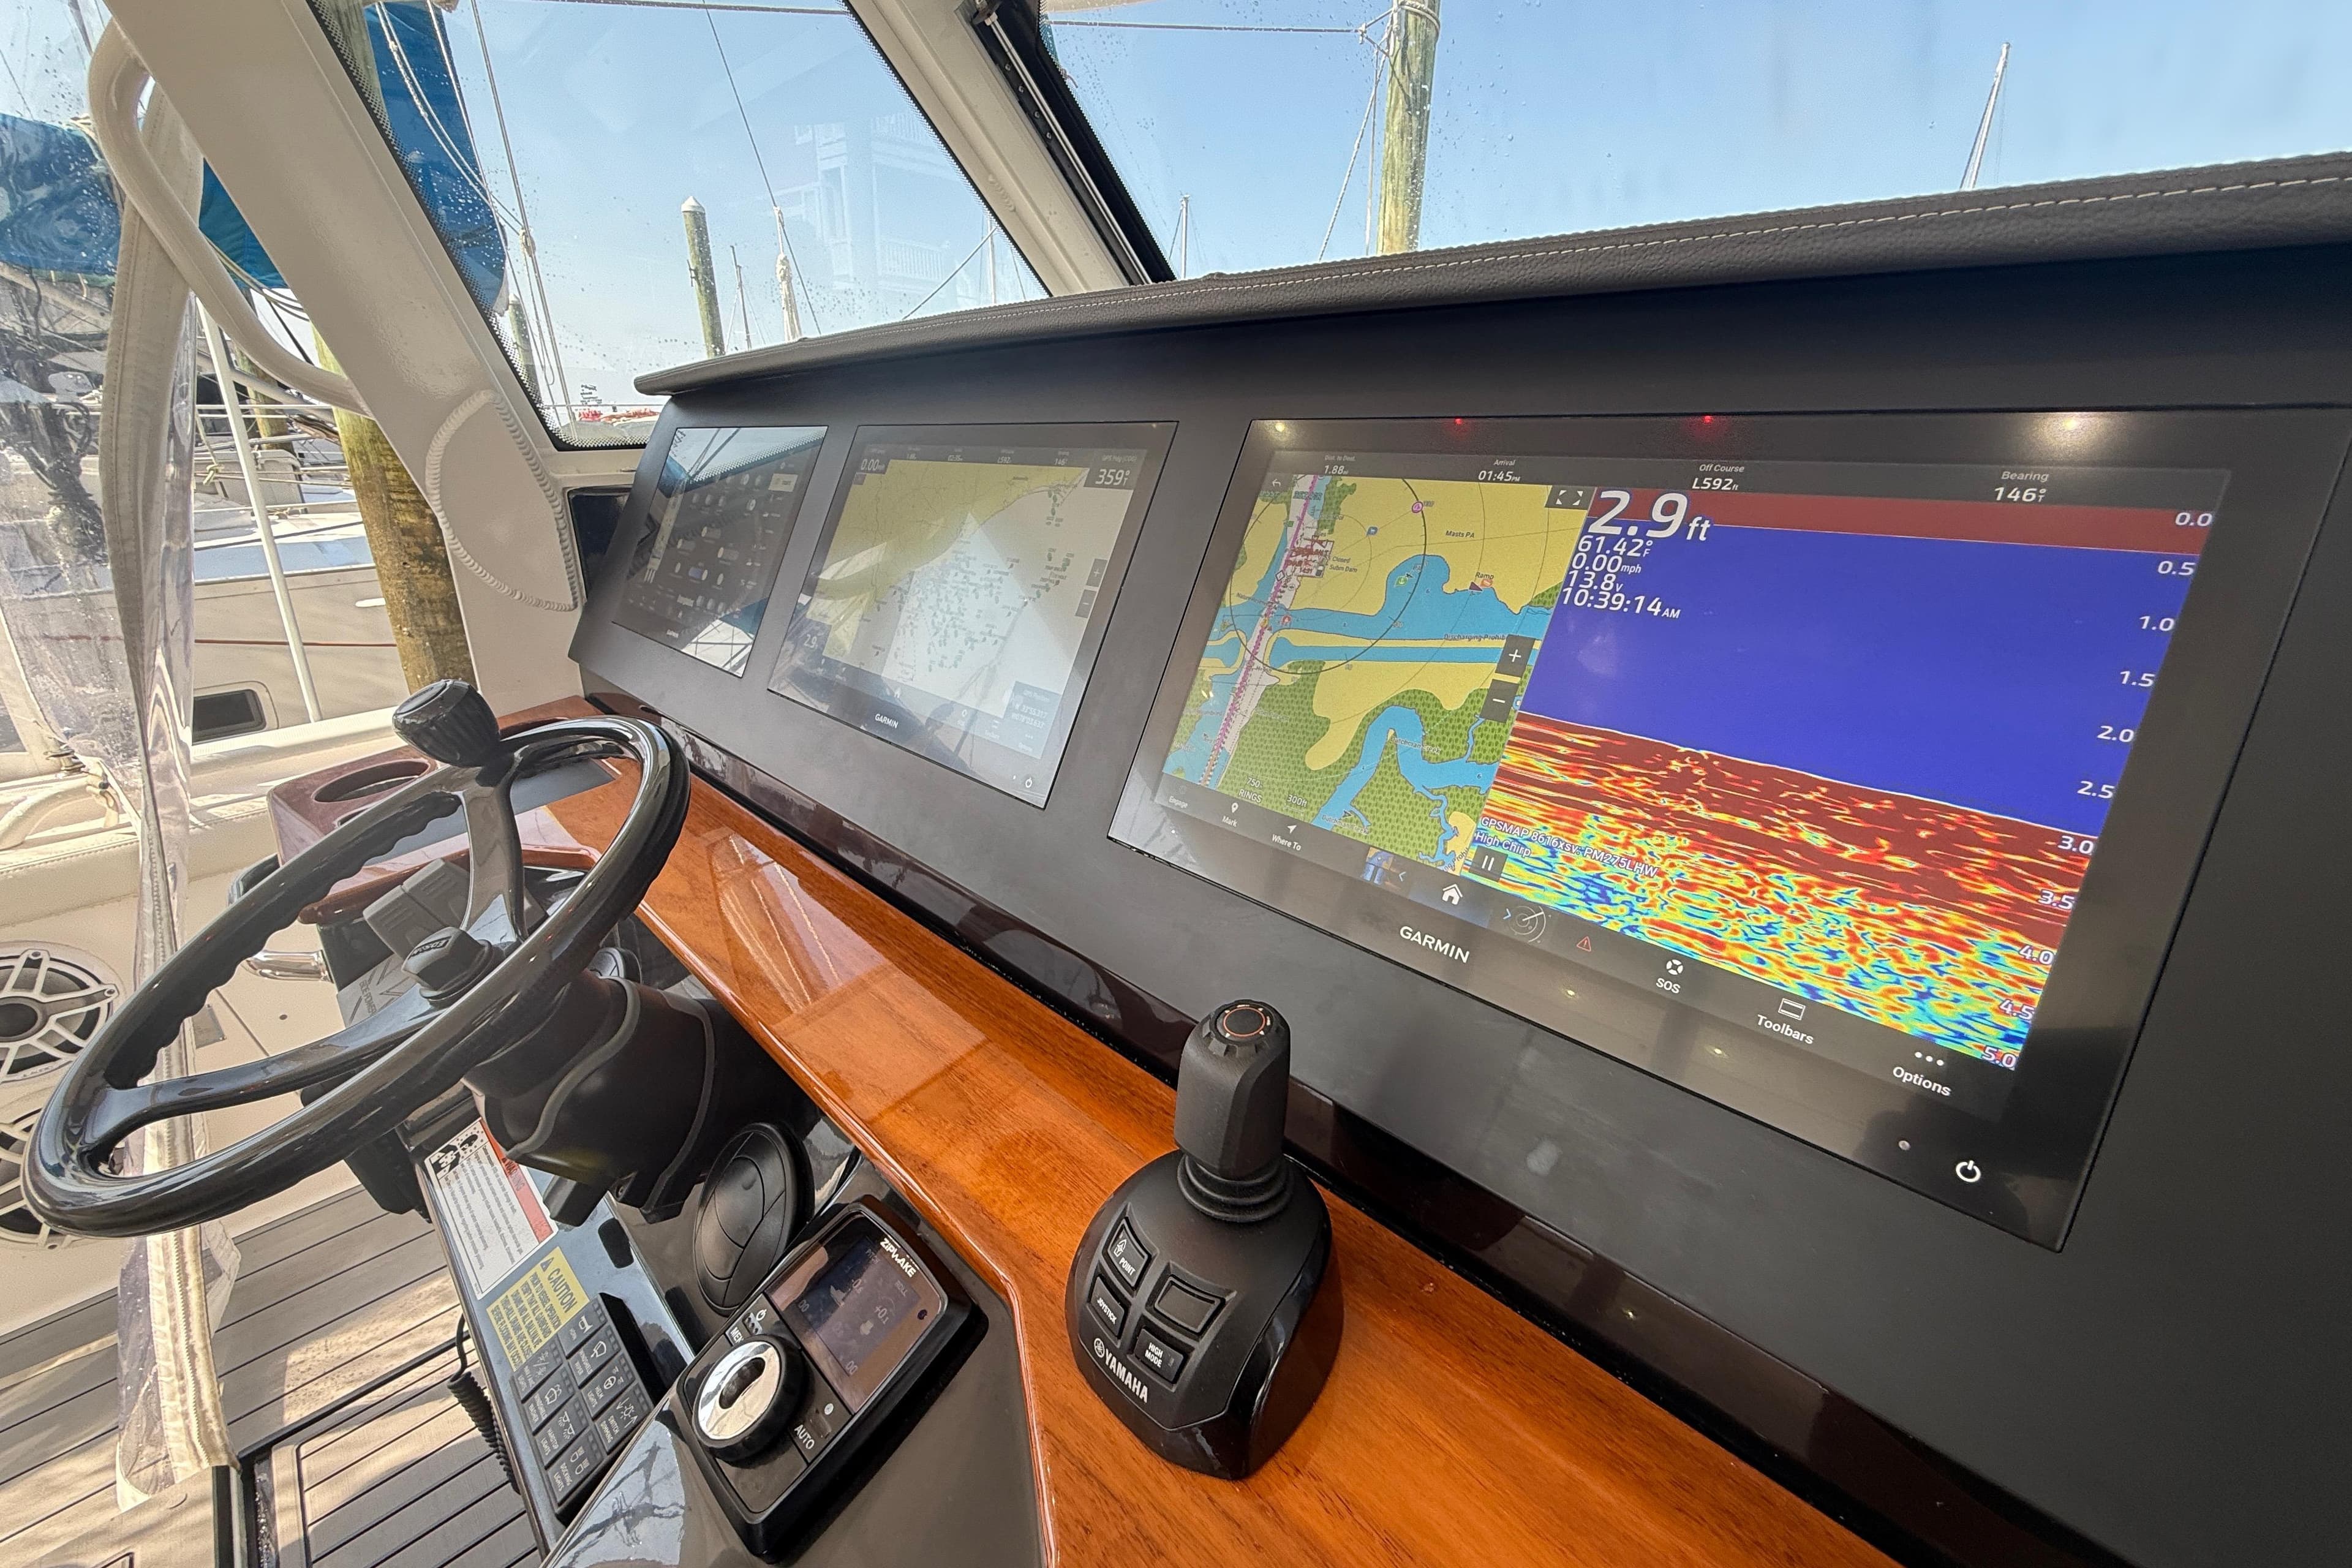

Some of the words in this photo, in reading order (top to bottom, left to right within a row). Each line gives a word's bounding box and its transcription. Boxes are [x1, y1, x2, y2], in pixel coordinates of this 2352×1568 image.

[2001, 471, 2049, 483] Bearing
[1588, 491, 1688, 538] 2.9
[1686, 516, 1711, 541] ft
[2175, 512, 2213, 527] 0.0
[2158, 560, 2196, 576] 0.5
[2139, 616, 2174, 631] 1.0
[2120, 671, 2155, 687] 1.5
[875, 714, 899, 729] GARMIN
[2097, 725, 2135, 743] 2.0
[1422, 743, 1441, 755] Creek
[1238, 789, 1263, 804] RINGS
[2077, 781, 2115, 799] 2.5
[1287, 794, 1308, 808] 300ft
[1223, 815, 1237, 827] Mark
[1272, 833, 1292, 848] Where
[1293, 842, 1302, 851] To
[1475, 831, 1499, 848] High
[1501, 839, 1531, 858] Chirp
[1482, 816, 1529, 837] GPSMAP
[1583, 847, 1659, 878] PM275LHW
[2058, 835, 2094, 854] 3.0
[2038, 890, 2075, 910] 3.5
[1400, 926, 1469, 963] GARMIN
[2019, 945, 2054, 965] 4.0
[1656, 978, 1681, 995] SOS
[1999, 999, 2035, 1020] 4.5
[1757, 1014, 1814, 1045] Toolbars
[1982, 1046, 2016, 1068] 5.0
[1892, 1066, 1952, 1097] Options
[1119, 1257, 1136, 1276] POINT
[548, 1268, 578, 1313] CAUTION
[1096, 1298, 1117, 1325] JOYSTICK
[730, 1327, 744, 1343] MEN
[1144, 1349, 1163, 1368] MODE
[1148, 1342, 1164, 1359] HIGH
[1104, 1348, 1148, 1403] YAMAHA
[595, 1385, 604, 1399] HELM
[608, 1415, 619, 1435] SWITCH
[794, 1424, 815, 1449] AUTO
[541, 1438, 551, 1456] LIGHTS
[553, 1473, 564, 1492] LIGHTS
